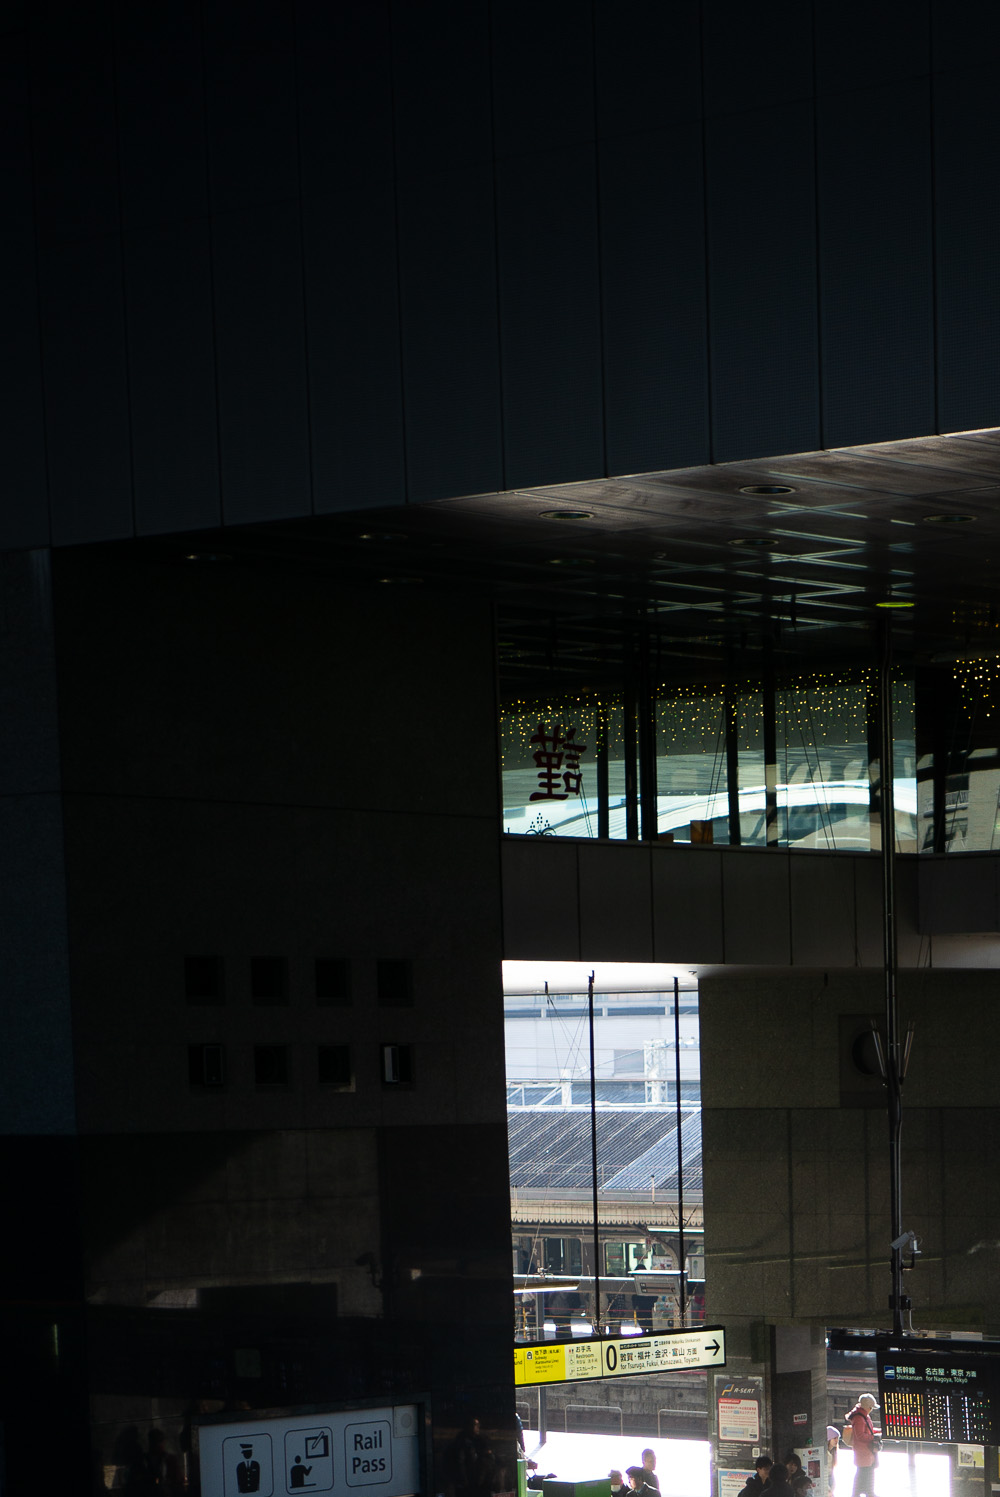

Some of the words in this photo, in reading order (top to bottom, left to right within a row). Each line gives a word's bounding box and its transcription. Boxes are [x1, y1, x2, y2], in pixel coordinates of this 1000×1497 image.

[606, 1345, 617, 1371] 0
[896, 1366, 915, 1375] 新幹線
[925, 1368, 963, 1376] 名古屋・東京
[934, 1376, 953, 1384] Nagoya,
[354, 1430, 383, 1451] Rail
[352, 1457, 386, 1474] Pass
